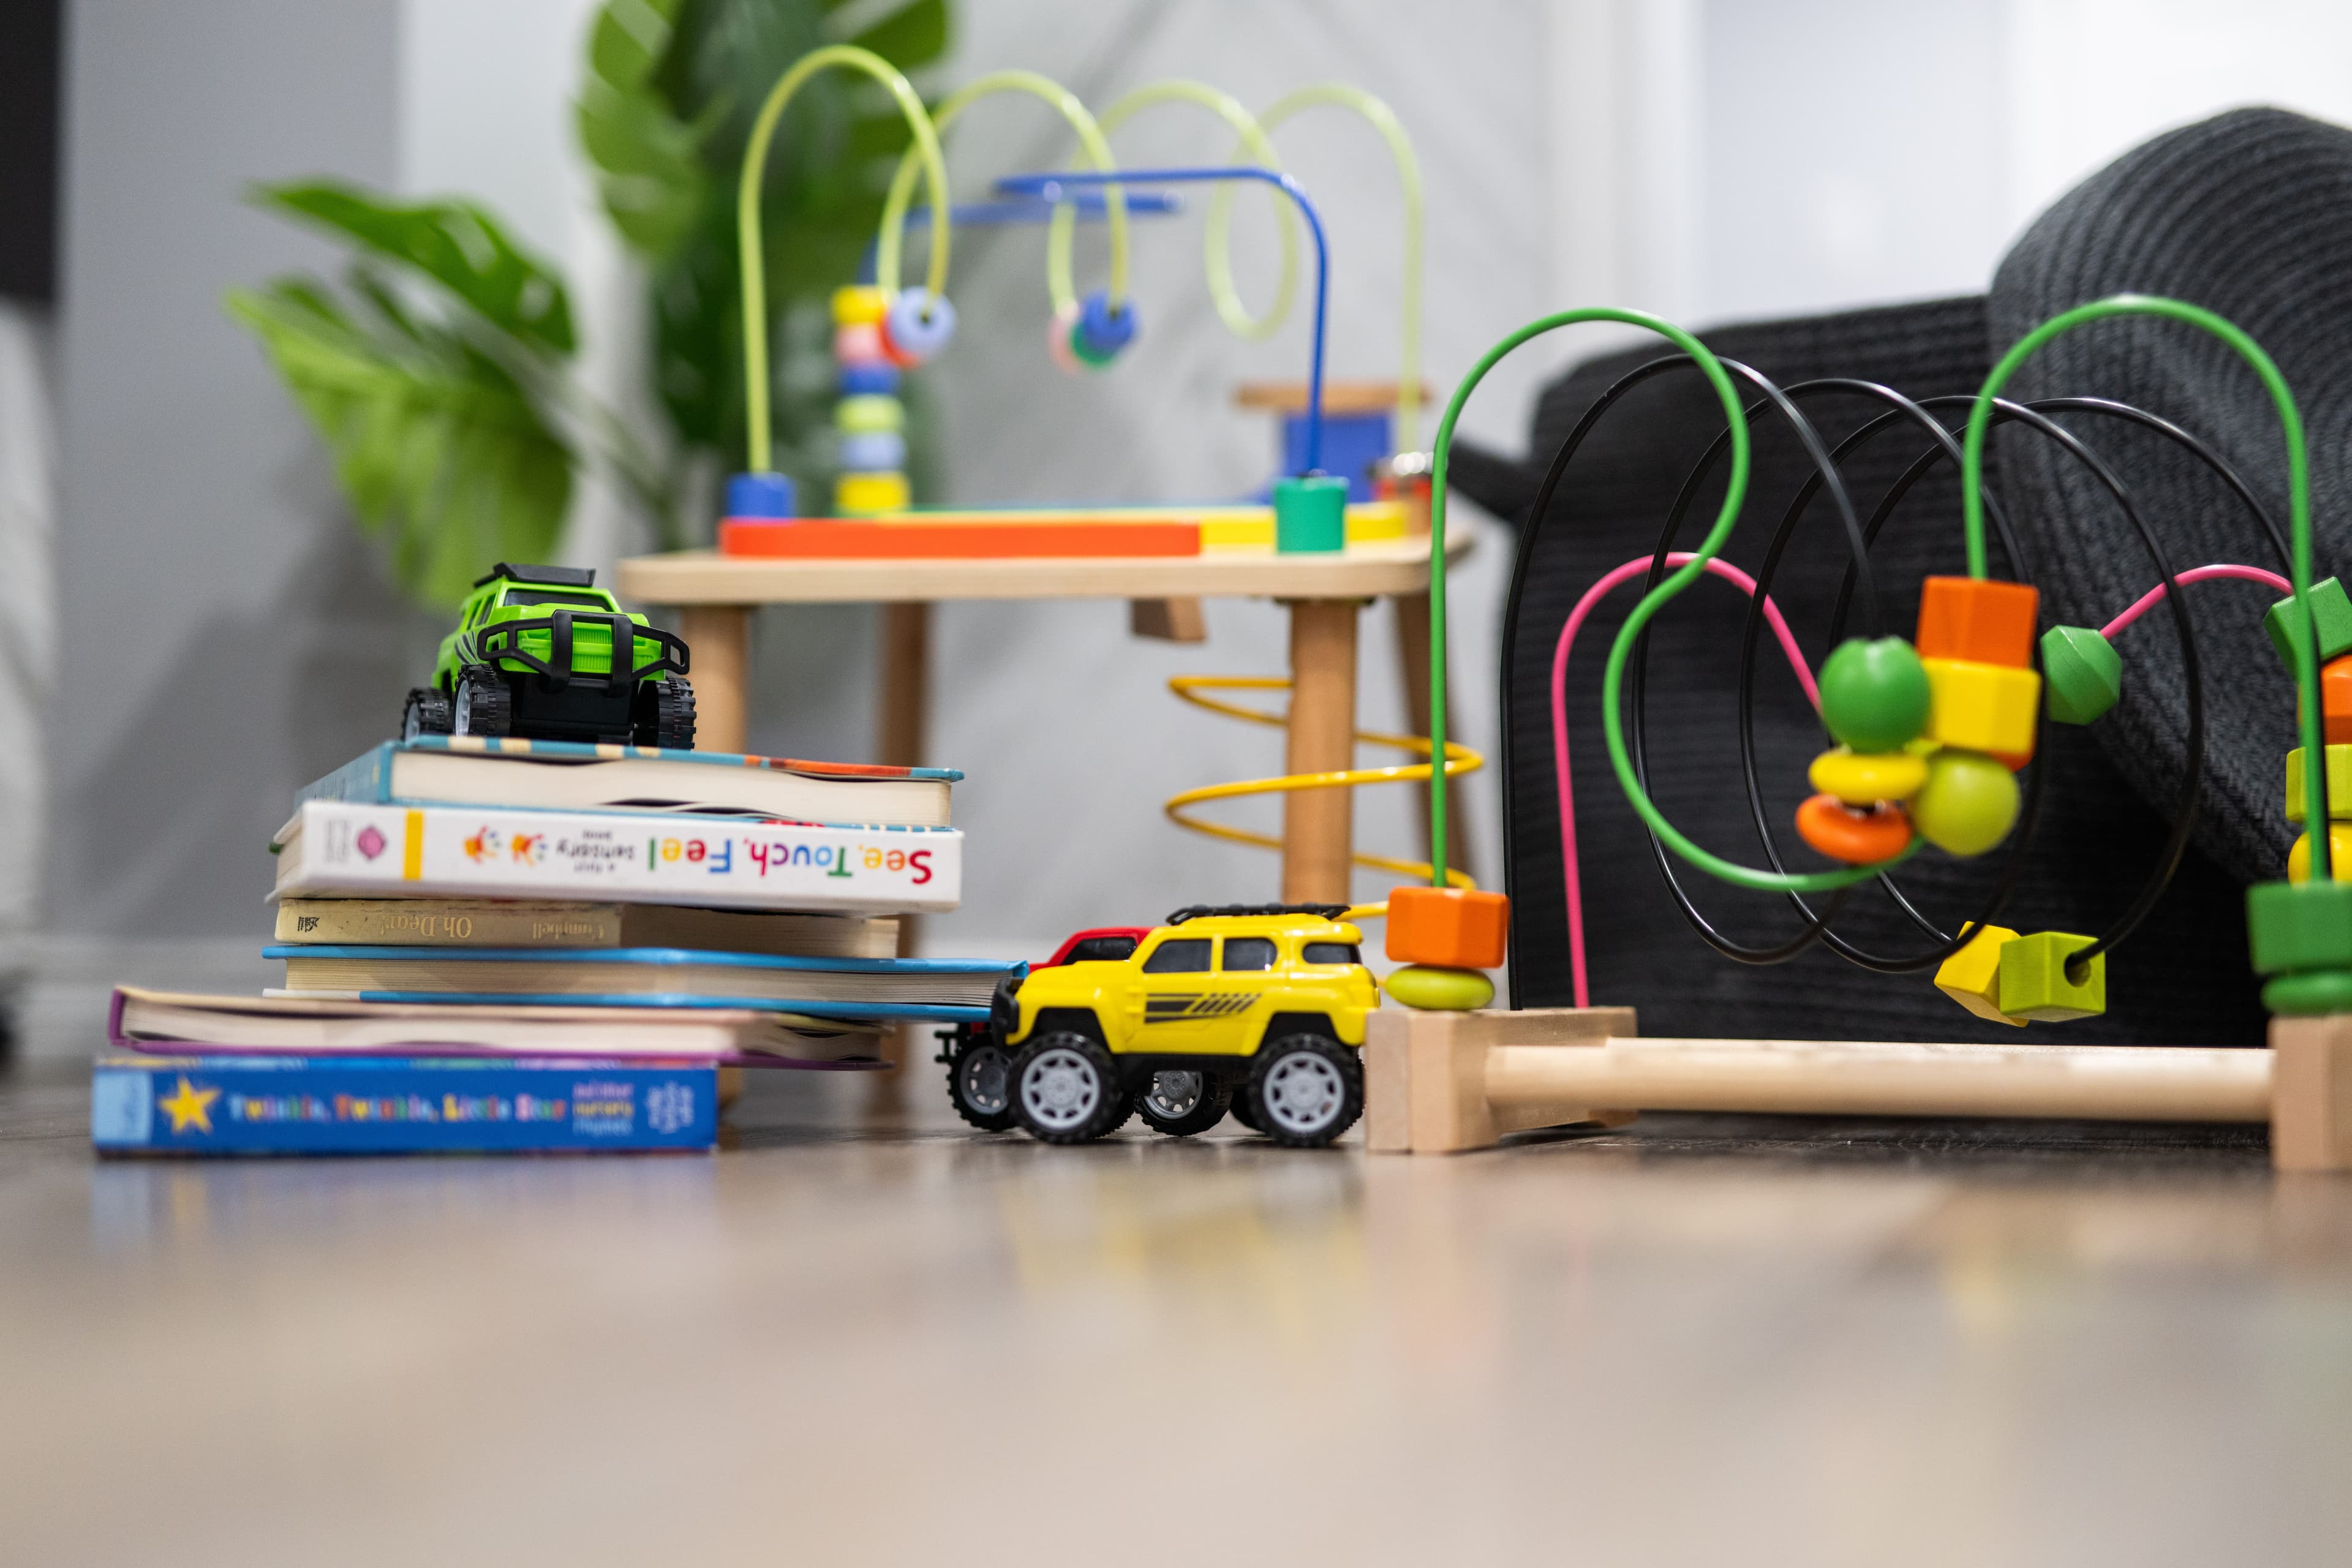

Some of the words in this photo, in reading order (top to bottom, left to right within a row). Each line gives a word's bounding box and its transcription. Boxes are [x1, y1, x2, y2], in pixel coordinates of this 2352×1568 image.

[649, 838, 731, 873] Feel
[742, 837, 854, 878] Touch,
[859, 845, 933, 884] See,
[379, 914, 437, 937] Dear!
[443, 916, 472, 938] Oh
